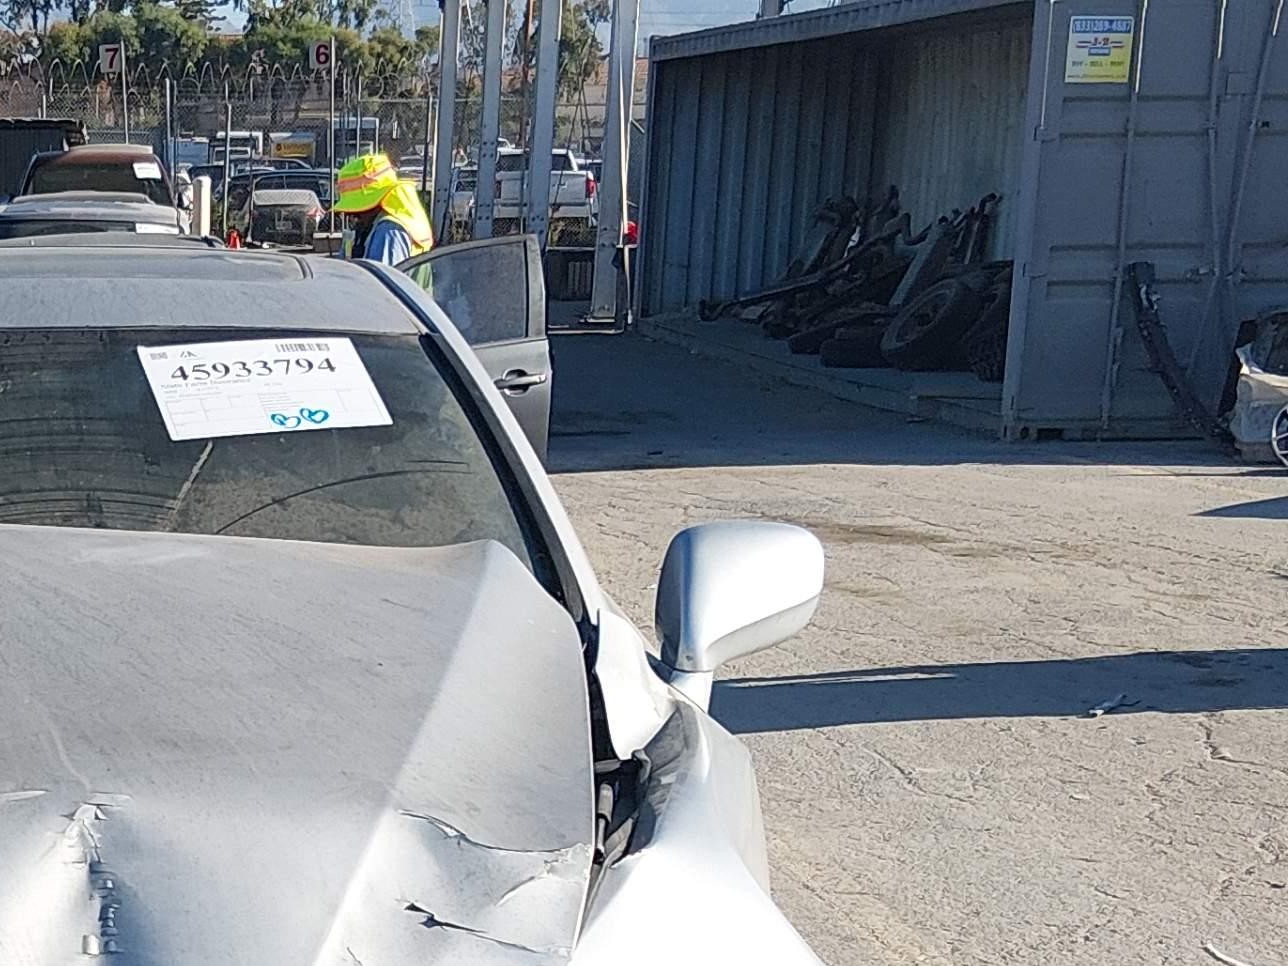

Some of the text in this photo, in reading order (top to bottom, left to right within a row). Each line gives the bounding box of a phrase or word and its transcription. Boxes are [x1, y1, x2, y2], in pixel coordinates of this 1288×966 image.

[105, 47, 119, 69] 7
[315, 44, 329, 65] 6
[171, 358, 337, 381] 45933794
